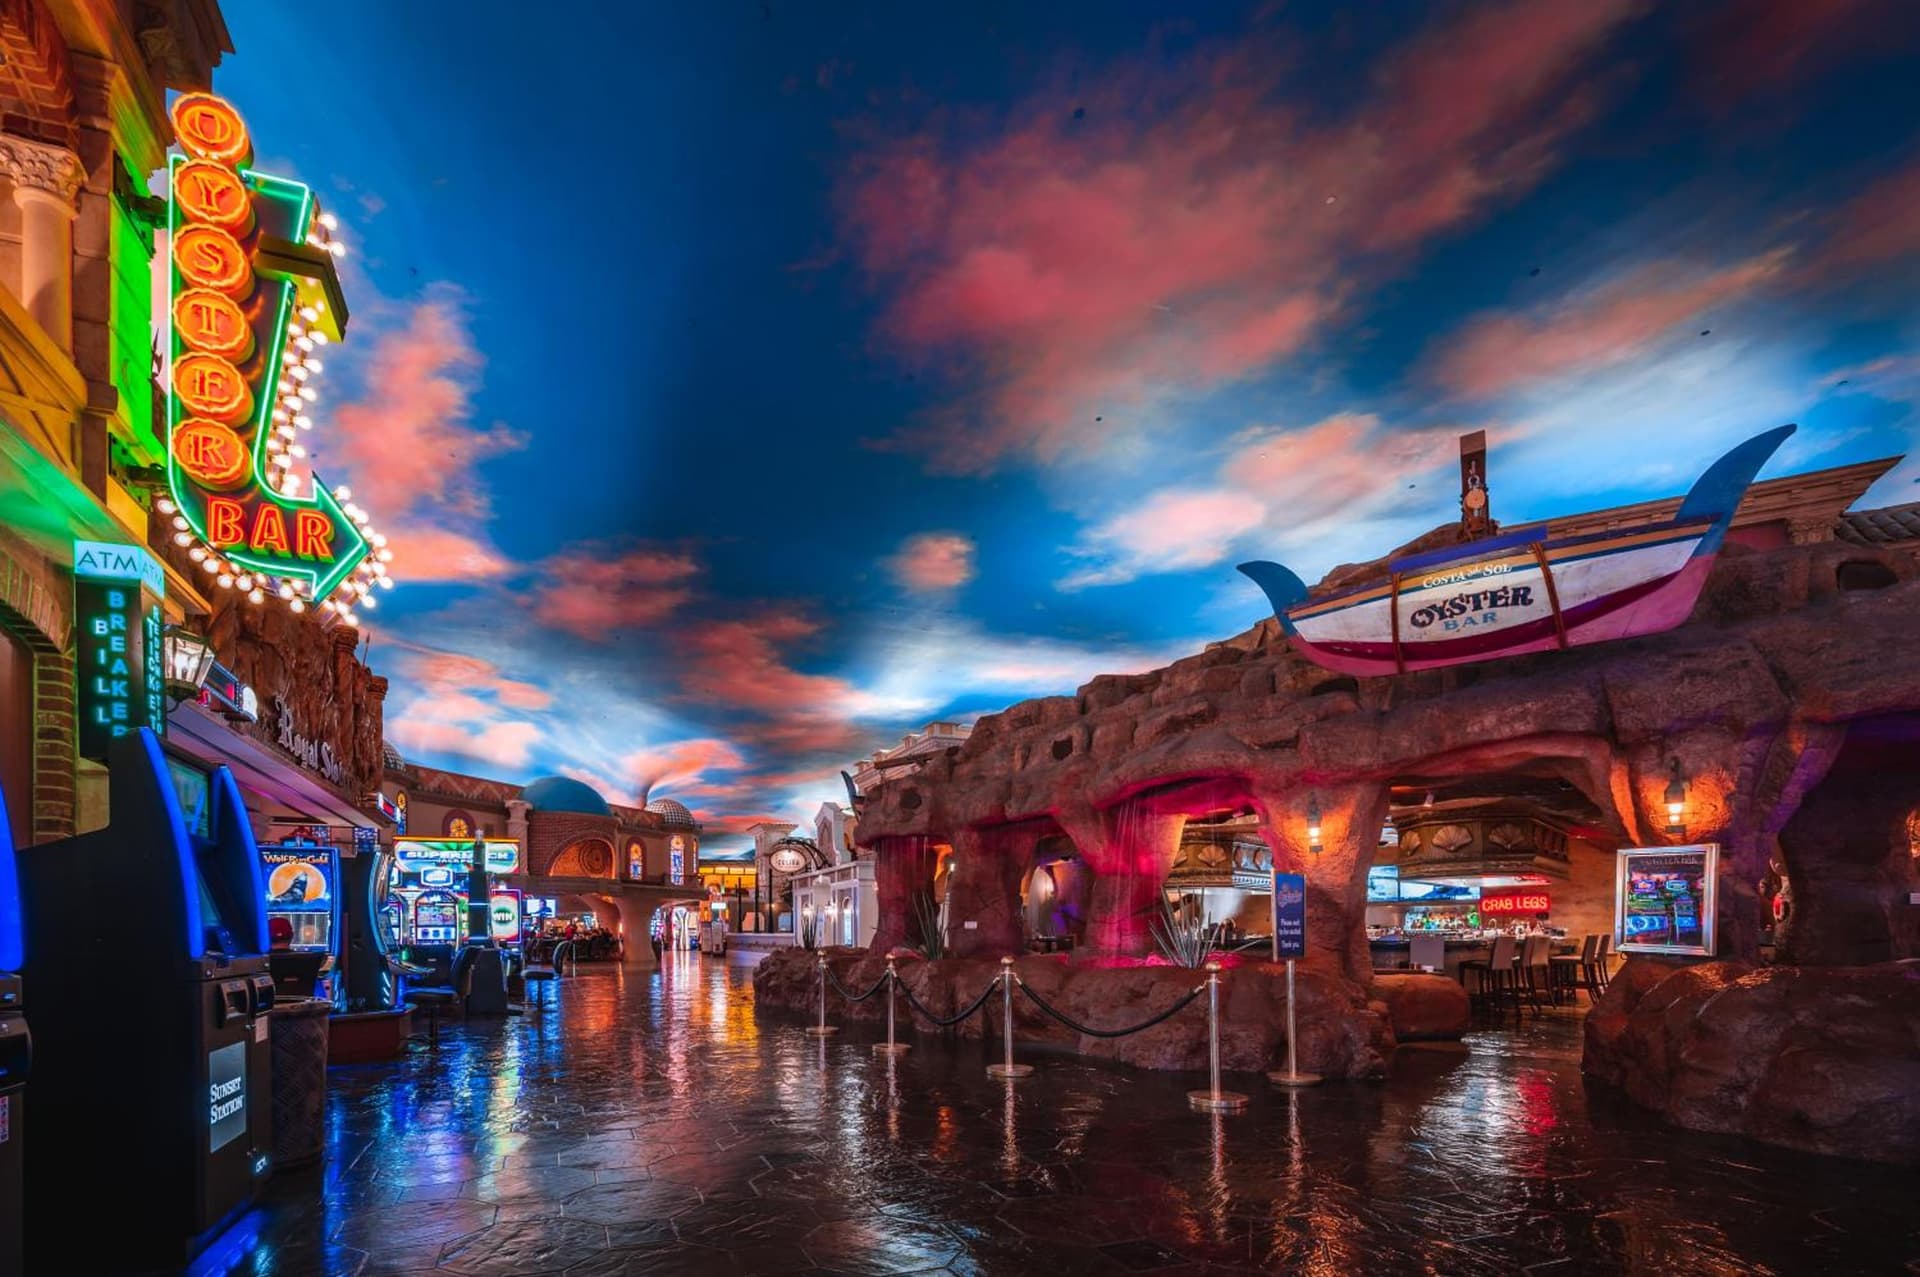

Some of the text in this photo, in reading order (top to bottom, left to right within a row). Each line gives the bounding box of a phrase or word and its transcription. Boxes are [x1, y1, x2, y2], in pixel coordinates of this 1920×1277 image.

[207, 496, 335, 559] BAR
[78, 549, 138, 572] ATM
[142, 562, 164, 585] ATM
[1423, 572, 1465, 589] COSTA
[1482, 563, 1513, 578] SOL
[1410, 585, 1534, 628] OYSTER
[1444, 611, 1498, 631] BAR
[95, 619, 111, 723] BILL
[275, 695, 319, 770] Royal
[493, 911, 513, 921] WIN
[1482, 896, 1549, 912] CRAB LEGS
[209, 1076, 242, 1104] SUNSET
[210, 1095, 246, 1125] STATION
